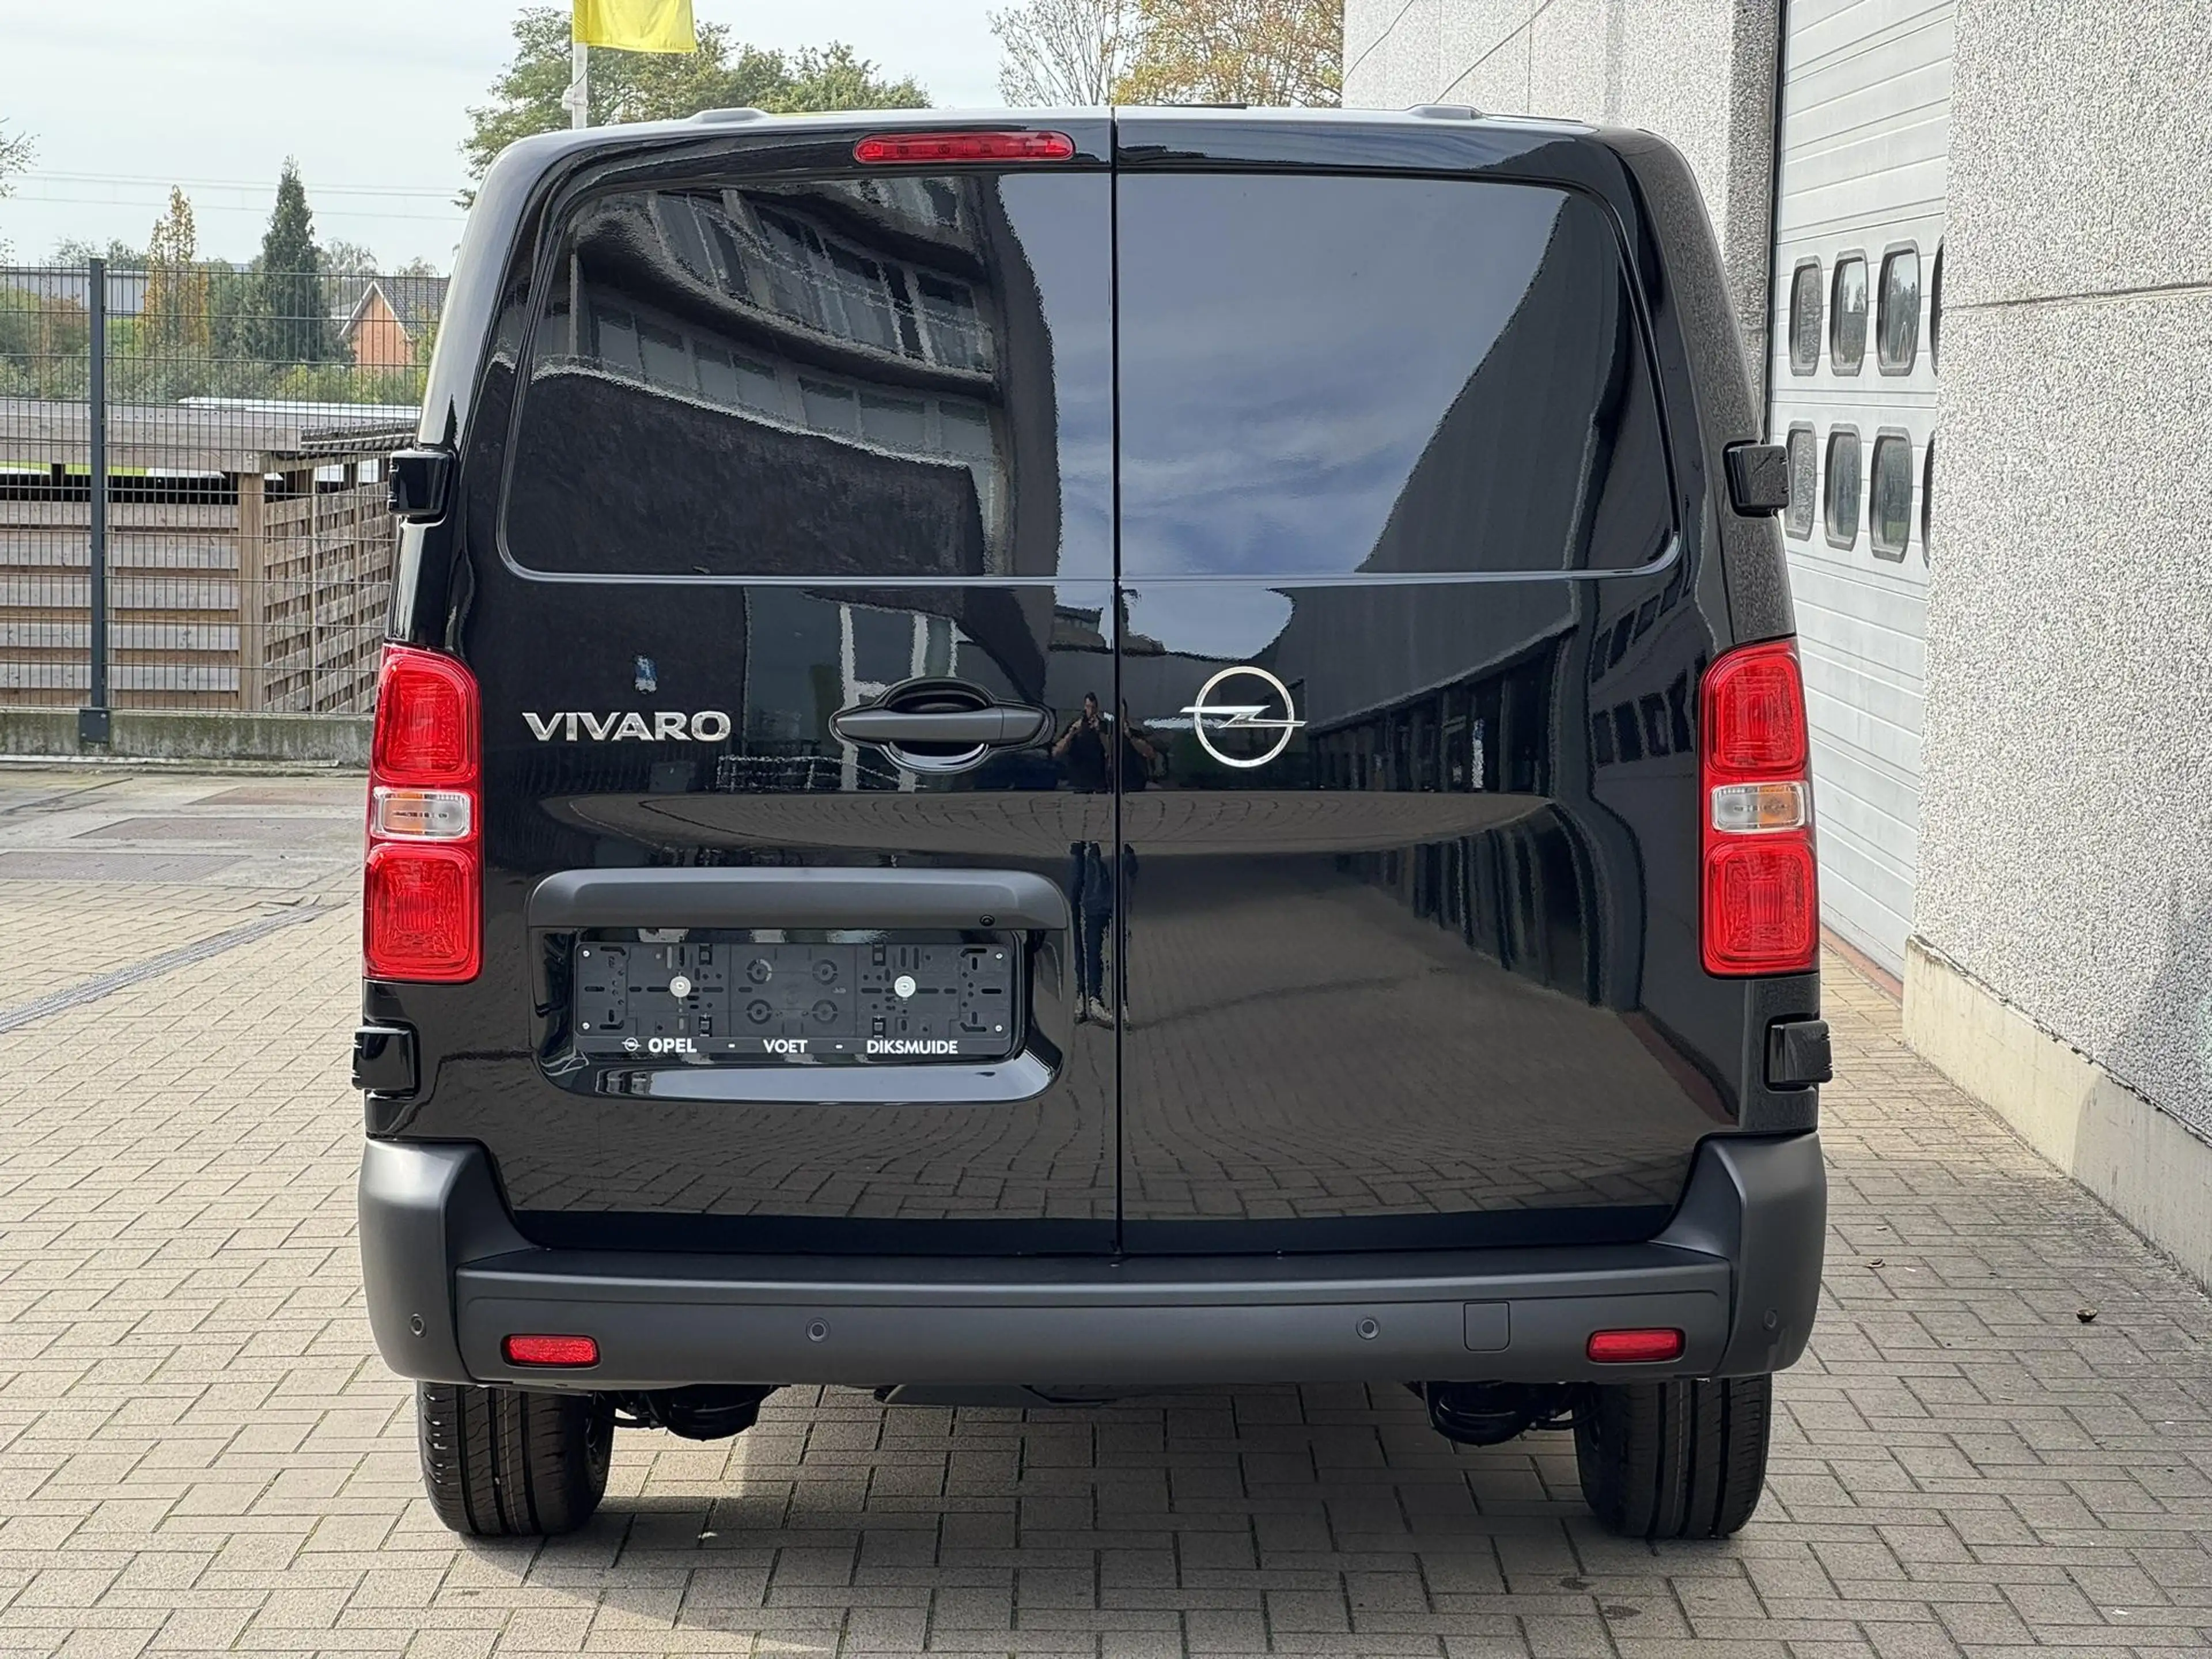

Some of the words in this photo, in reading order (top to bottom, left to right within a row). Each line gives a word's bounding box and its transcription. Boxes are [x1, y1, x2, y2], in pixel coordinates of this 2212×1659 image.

[522, 711, 731, 741] VIVARO
[648, 1038, 698, 1053] OPEL
[763, 1039, 808, 1054] VOET
[866, 1040, 959, 1054] DIKSMUIDE
